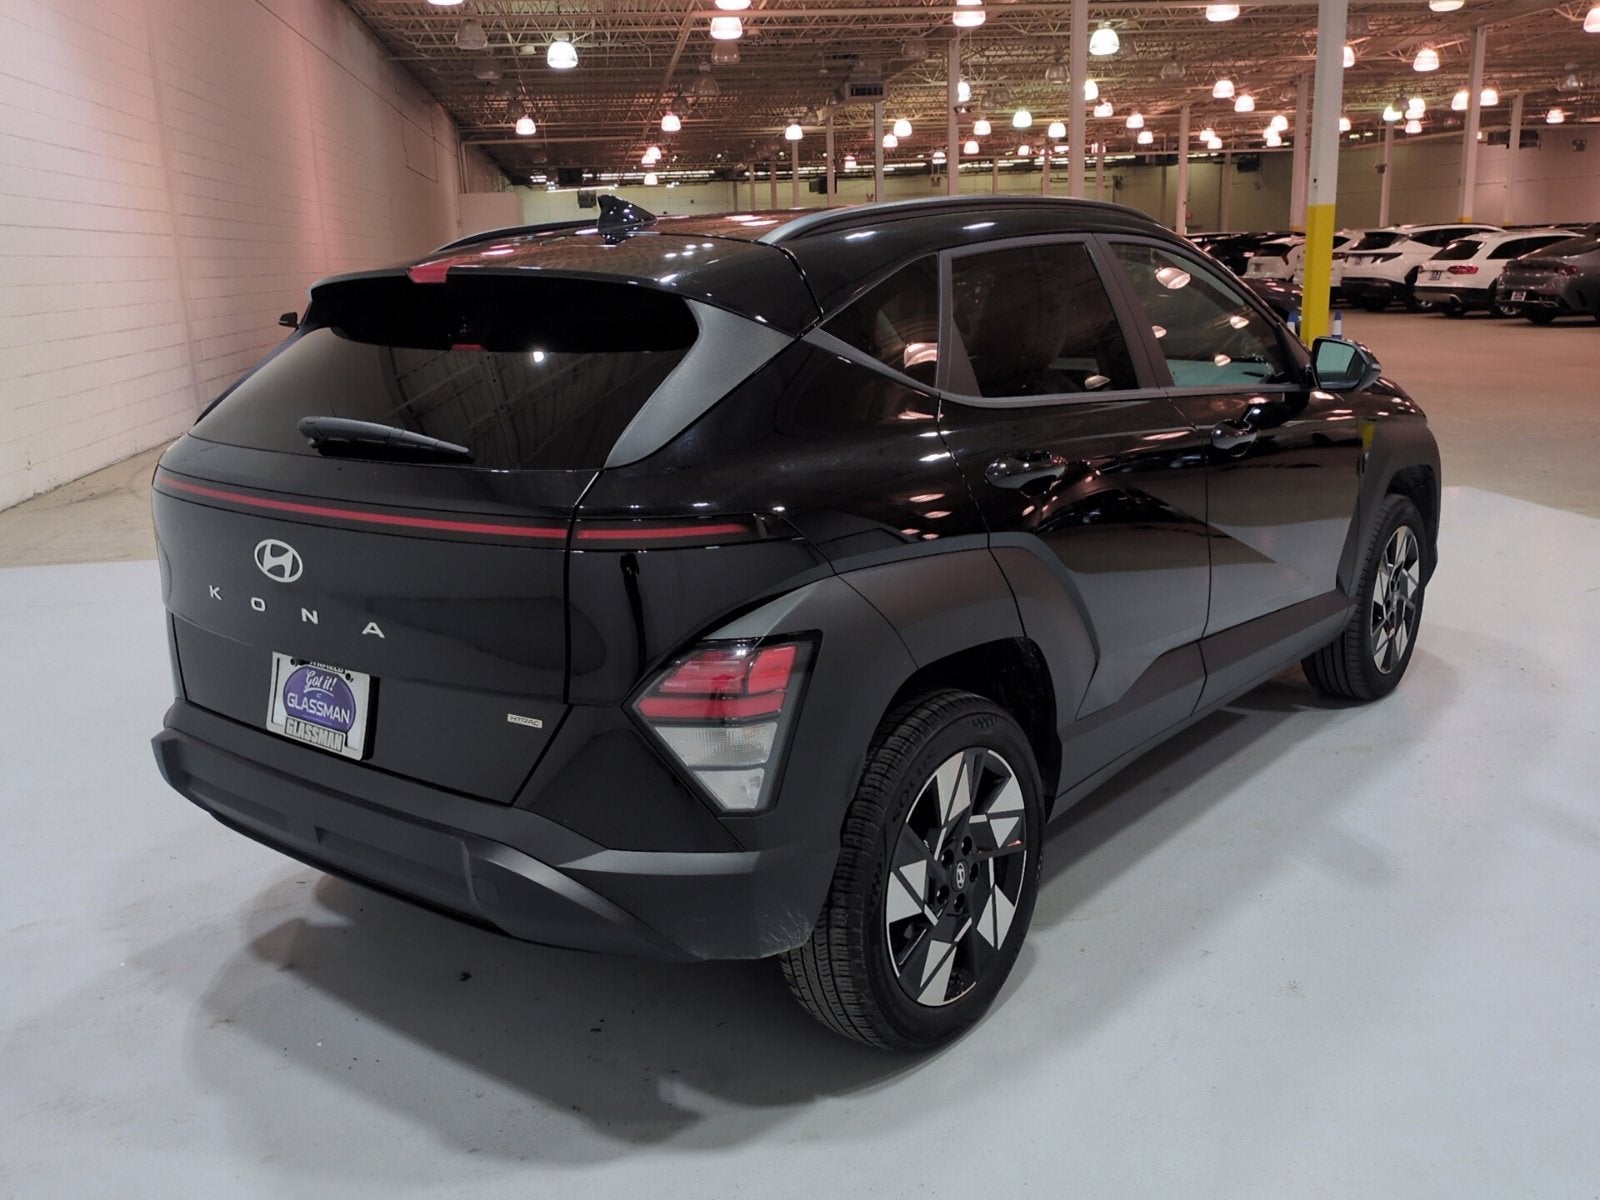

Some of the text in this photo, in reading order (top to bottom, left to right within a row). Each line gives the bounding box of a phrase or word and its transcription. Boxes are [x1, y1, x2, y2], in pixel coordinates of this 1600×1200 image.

[209, 584, 386, 639] KONA
[305, 669, 338, 691] Got it!
[287, 692, 351, 725] GLASSMAN
[509, 715, 540, 727] HTRAC
[286, 718, 343, 752] GLASSMAN
